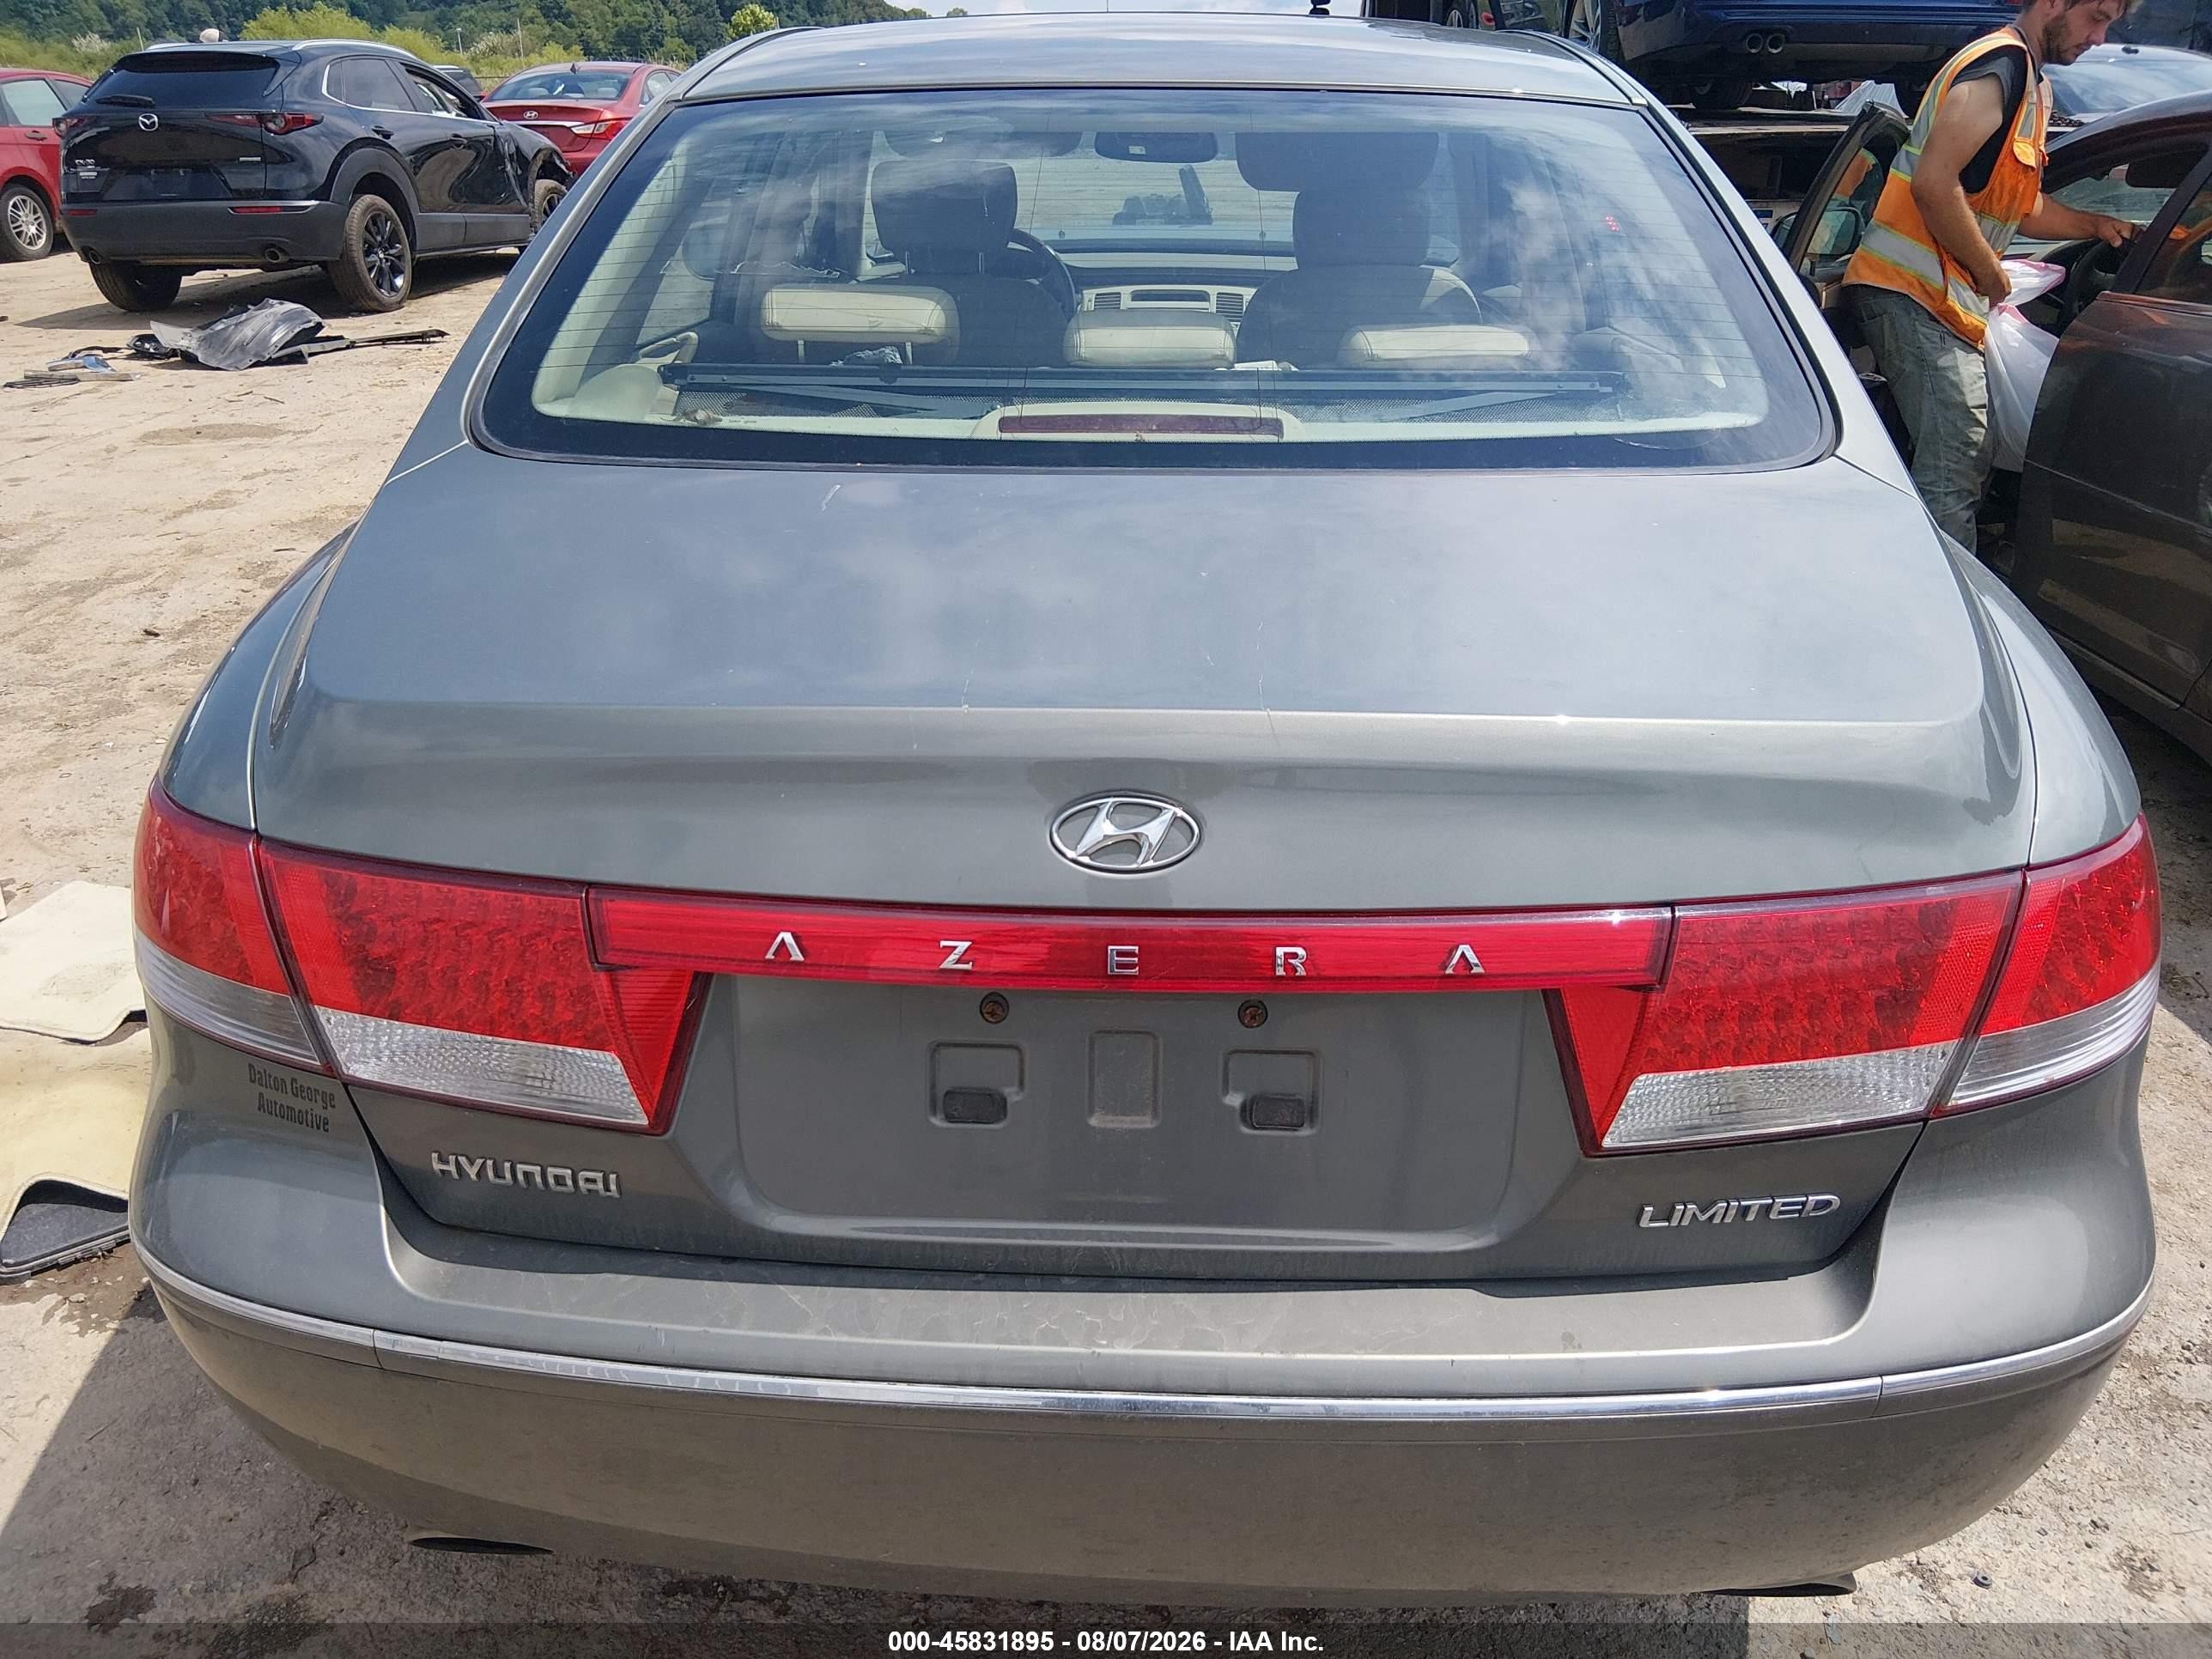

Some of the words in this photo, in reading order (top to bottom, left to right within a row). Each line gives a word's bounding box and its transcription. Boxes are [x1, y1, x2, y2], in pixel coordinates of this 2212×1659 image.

[765, 931, 1486, 975] AZERA
[248, 1063, 288, 1095] Dalton
[290, 1077, 336, 1110] George
[258, 1091, 330, 1133] Automotive
[431, 1152, 621, 1199] HYUNDAI
[1638, 1194, 1841, 1228] LIMITED
